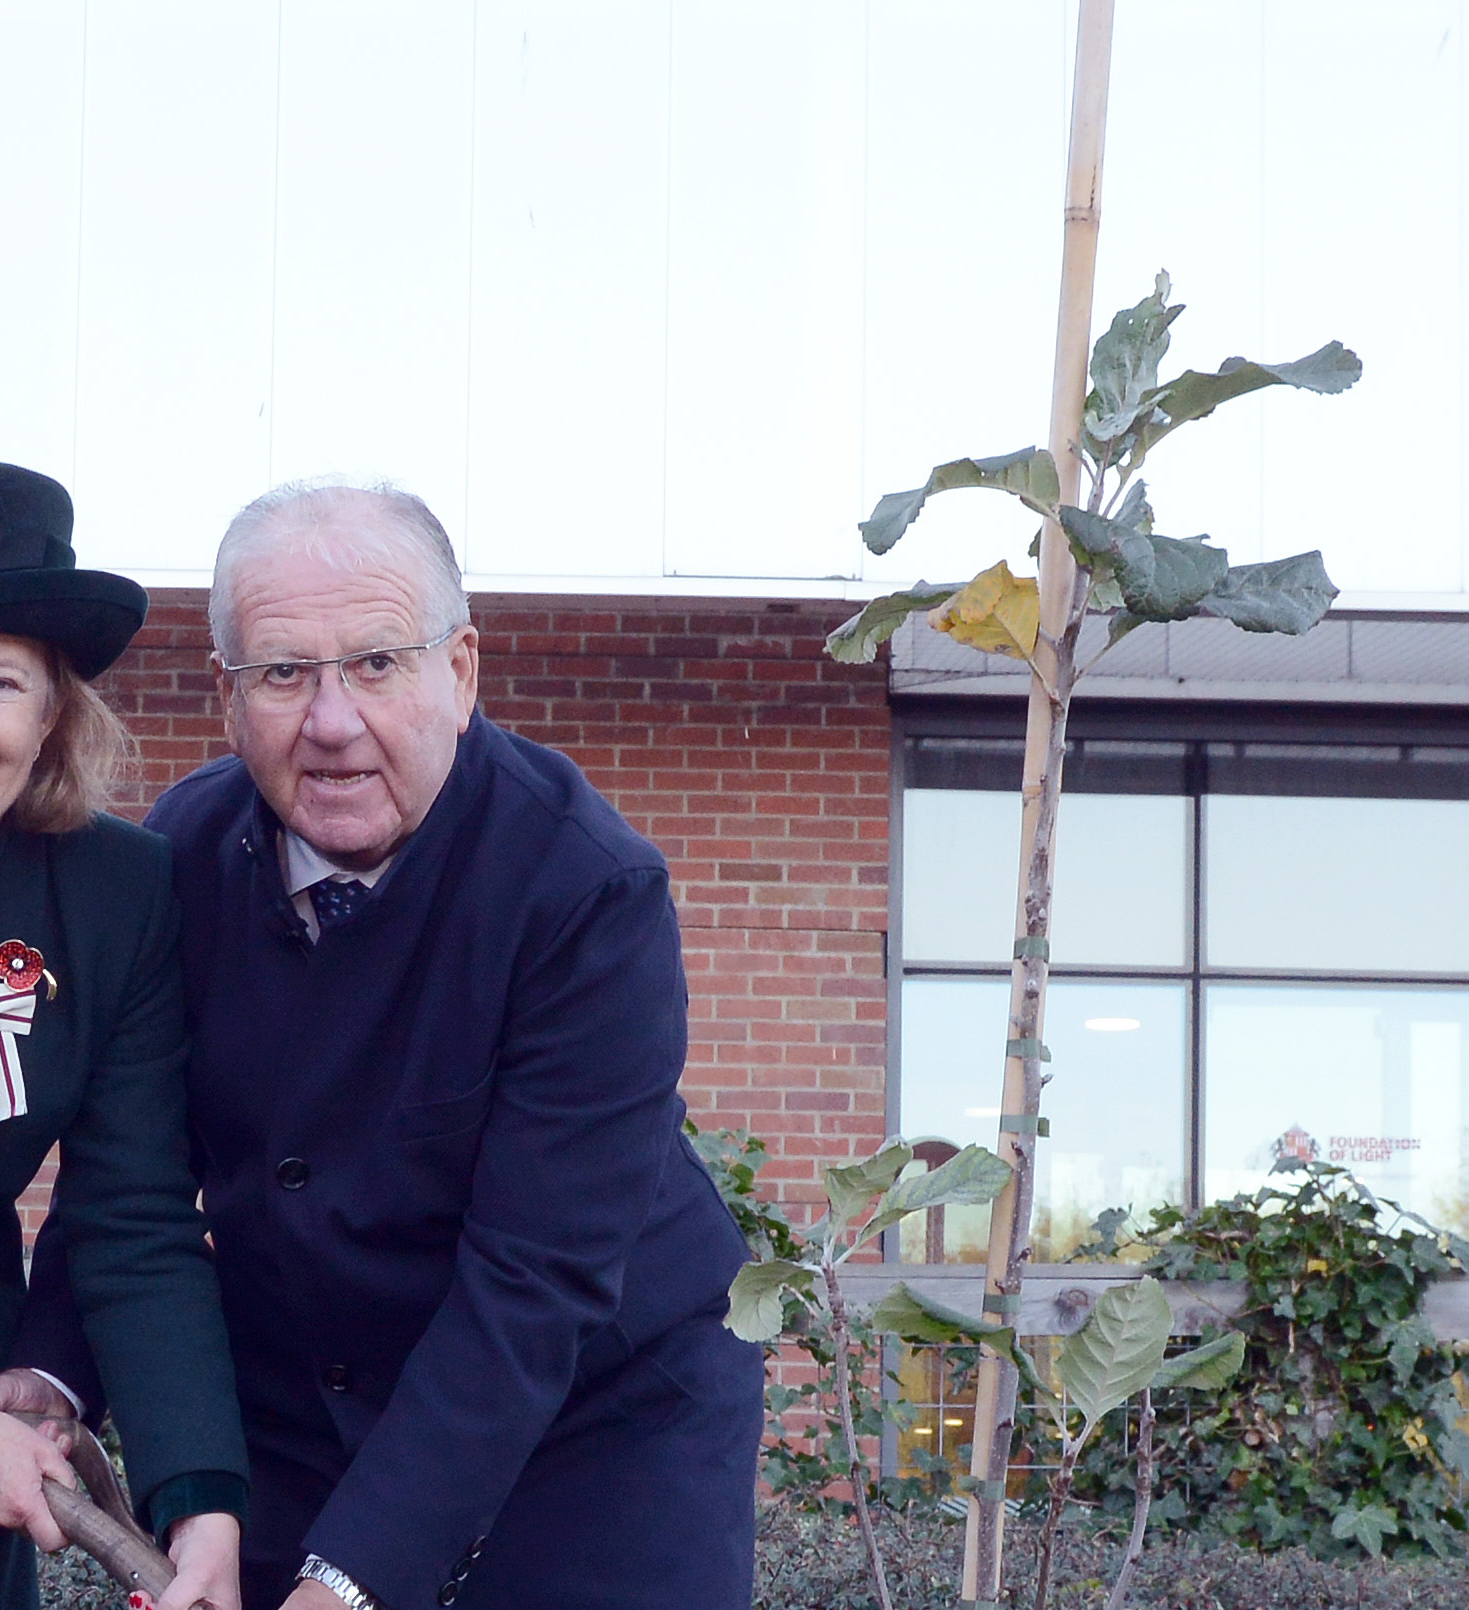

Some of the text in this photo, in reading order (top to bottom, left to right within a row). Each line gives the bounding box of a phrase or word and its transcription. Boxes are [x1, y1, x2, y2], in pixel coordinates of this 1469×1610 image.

[1329, 1136, 1421, 1150] FOUNDATION
[1329, 1149, 1394, 1162] OF LIGHT
